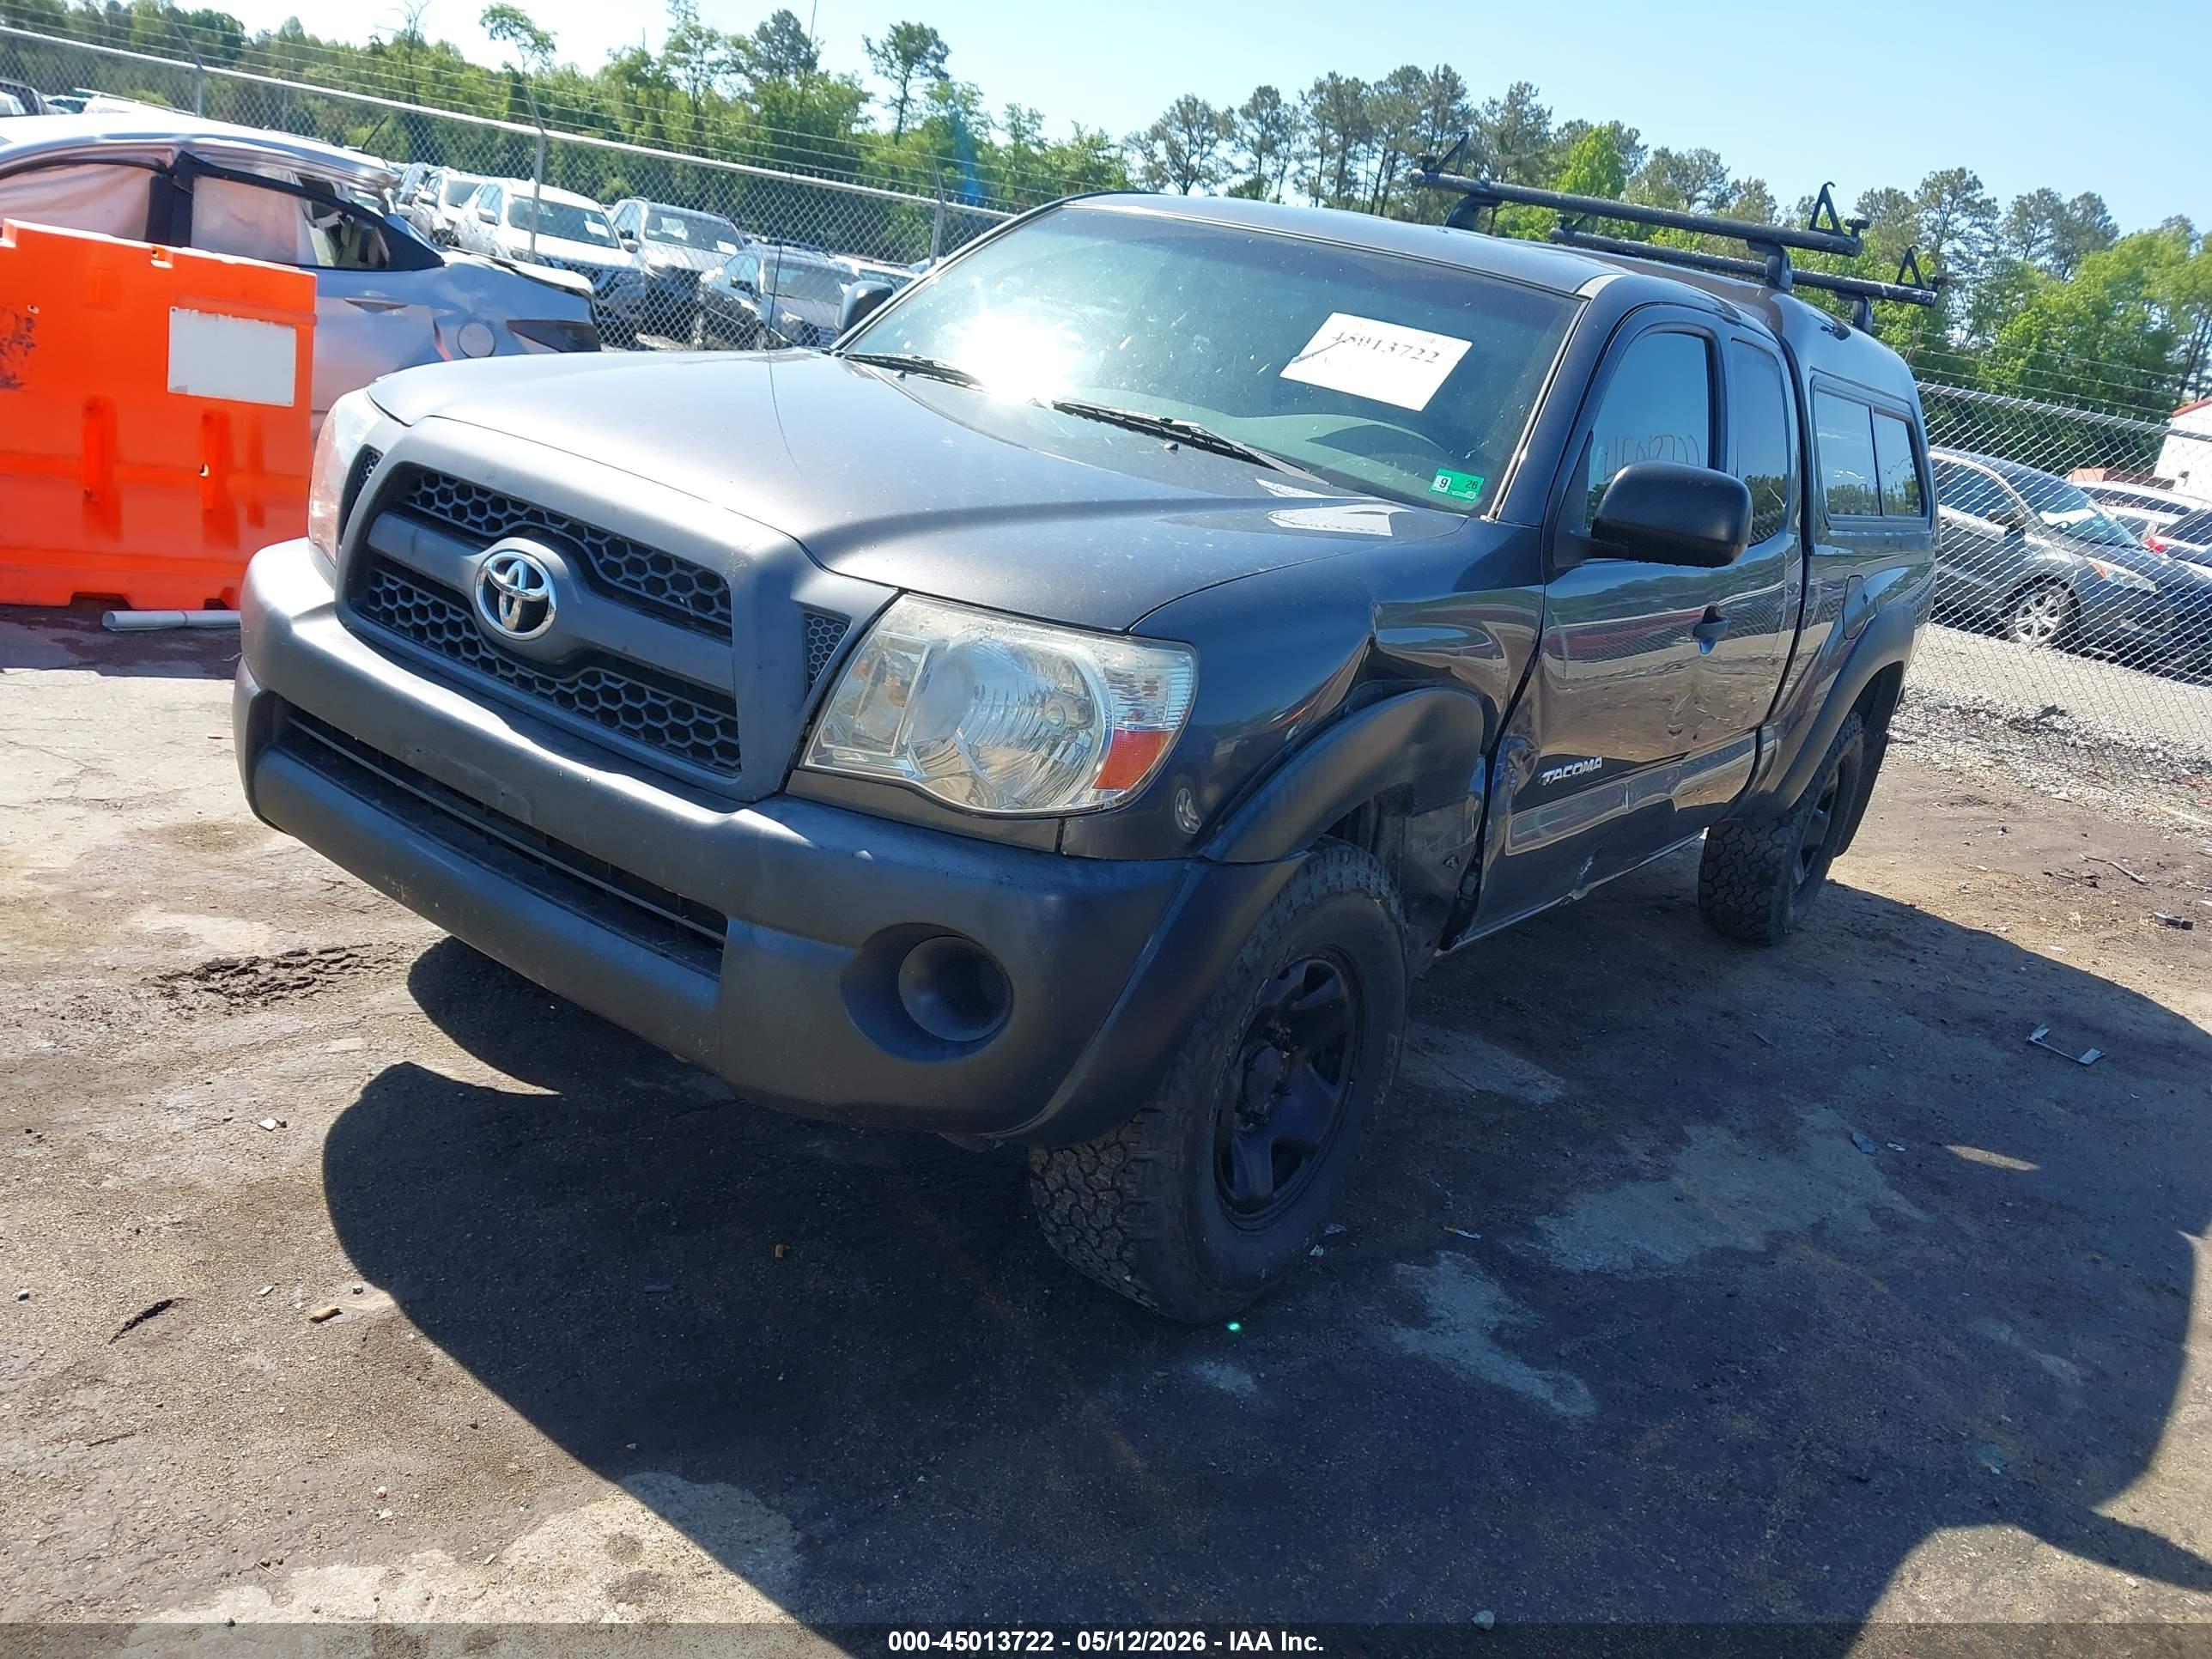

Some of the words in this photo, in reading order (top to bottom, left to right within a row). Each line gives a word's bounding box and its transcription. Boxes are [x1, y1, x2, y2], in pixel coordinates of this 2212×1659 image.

[1439, 477, 1449, 489] 9
[1466, 480, 1479, 489] 26
[1539, 757, 1602, 786] TACOMA
